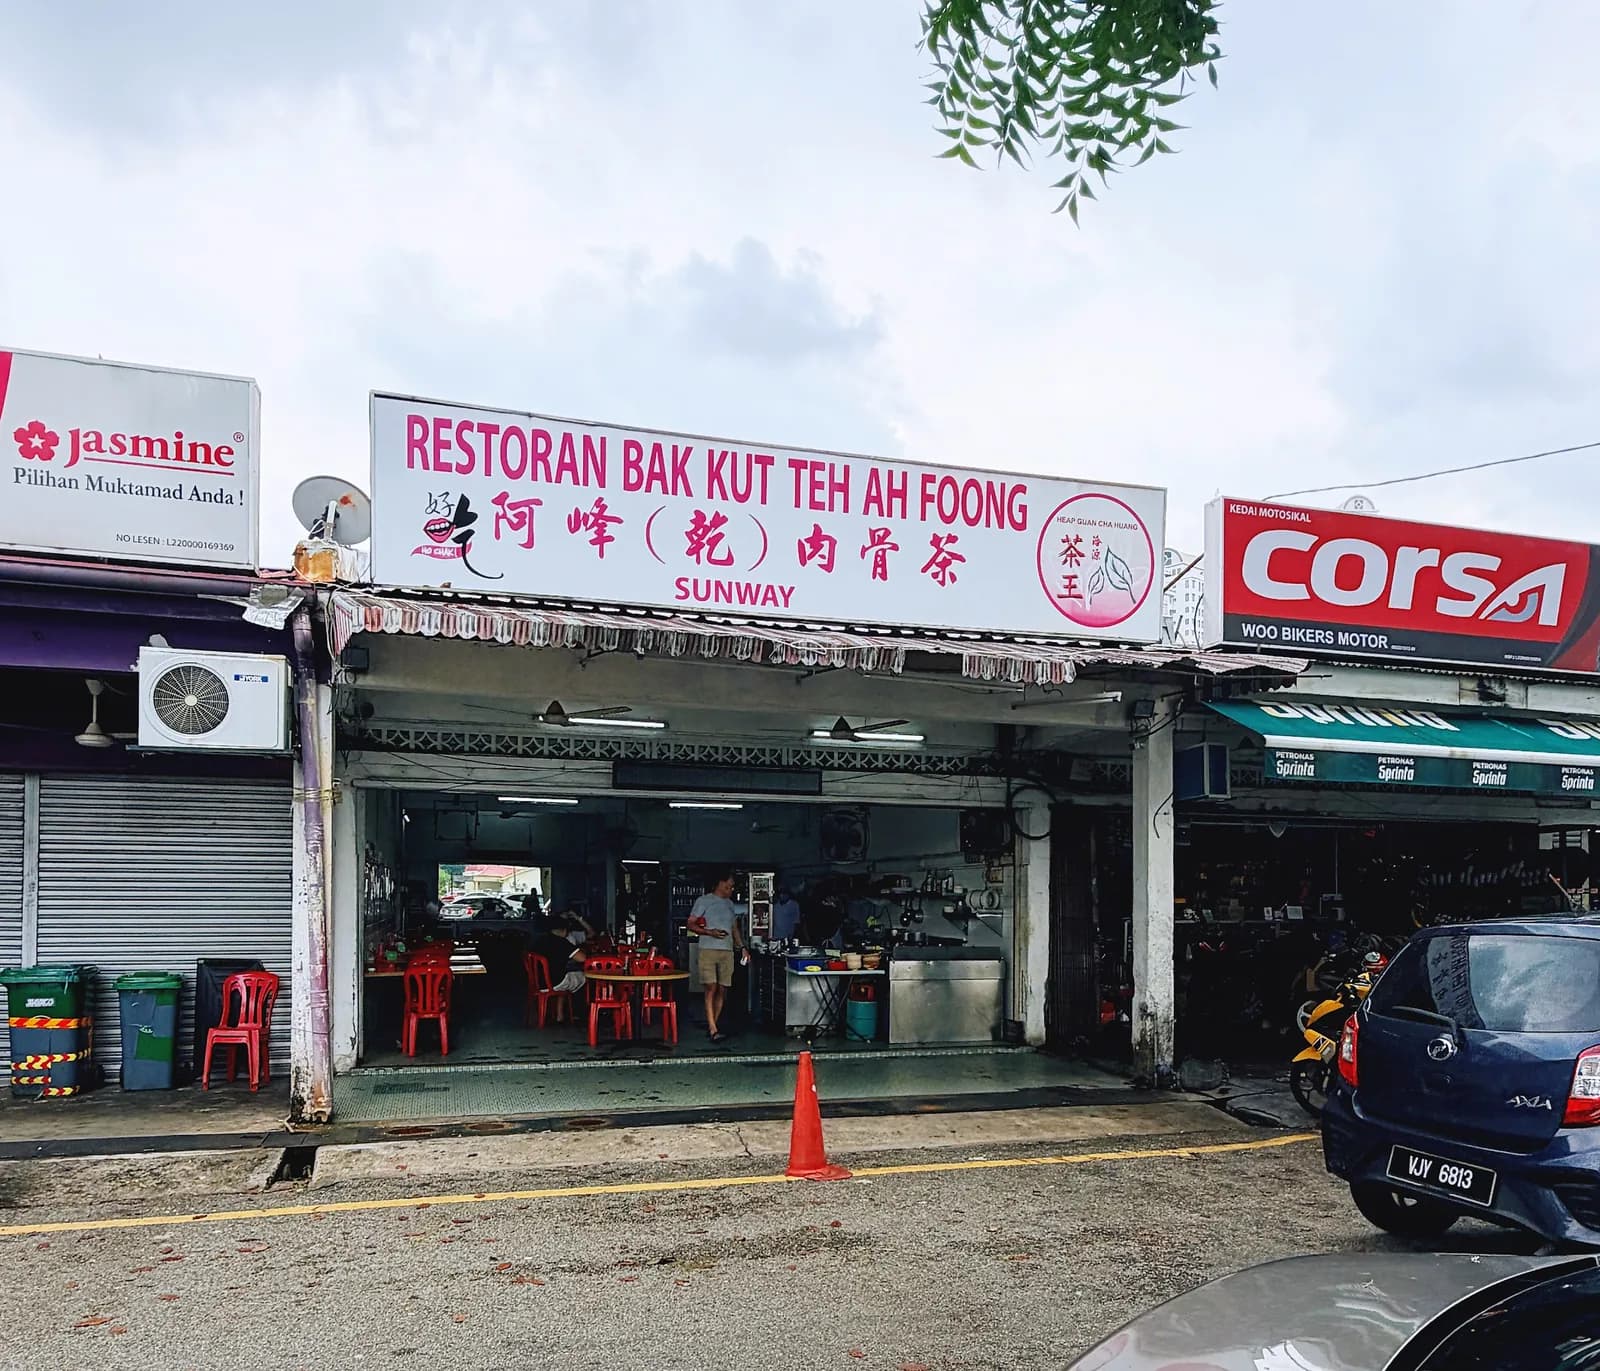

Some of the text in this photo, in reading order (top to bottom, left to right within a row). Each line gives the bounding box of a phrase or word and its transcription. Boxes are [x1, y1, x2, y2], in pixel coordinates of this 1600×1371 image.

[64, 427, 235, 468] Jasmine
[407, 414, 1028, 531] RESTORAN BAK KUT TEH AH FOONG
[14, 467, 79, 490] Pilihan
[85, 474, 183, 500] Muktamad
[1229, 503, 1312, 523] KEDAI MOTOSIKAL
[1057, 516, 1138, 531] HEAP GUAN CHA HUANG
[116, 533, 131, 543] NO
[132, 535, 160, 545] LESEN
[674, 576, 795, 609] SUNWAY
[1241, 622, 1389, 649] WOO BIKERS MOTOR
[1275, 750, 1315, 761] PETRONAS
[1377, 756, 1414, 766] PETRONAS
[1276, 760, 1315, 777] Sprinta
[1378, 765, 1414, 782] Sprinta
[1472, 761, 1507, 771] PETRONAS
[1472, 770, 1507, 786] Sprinta
[1561, 775, 1594, 791] Sprinta
[1408, 1155, 1473, 1189] VJY 6813
